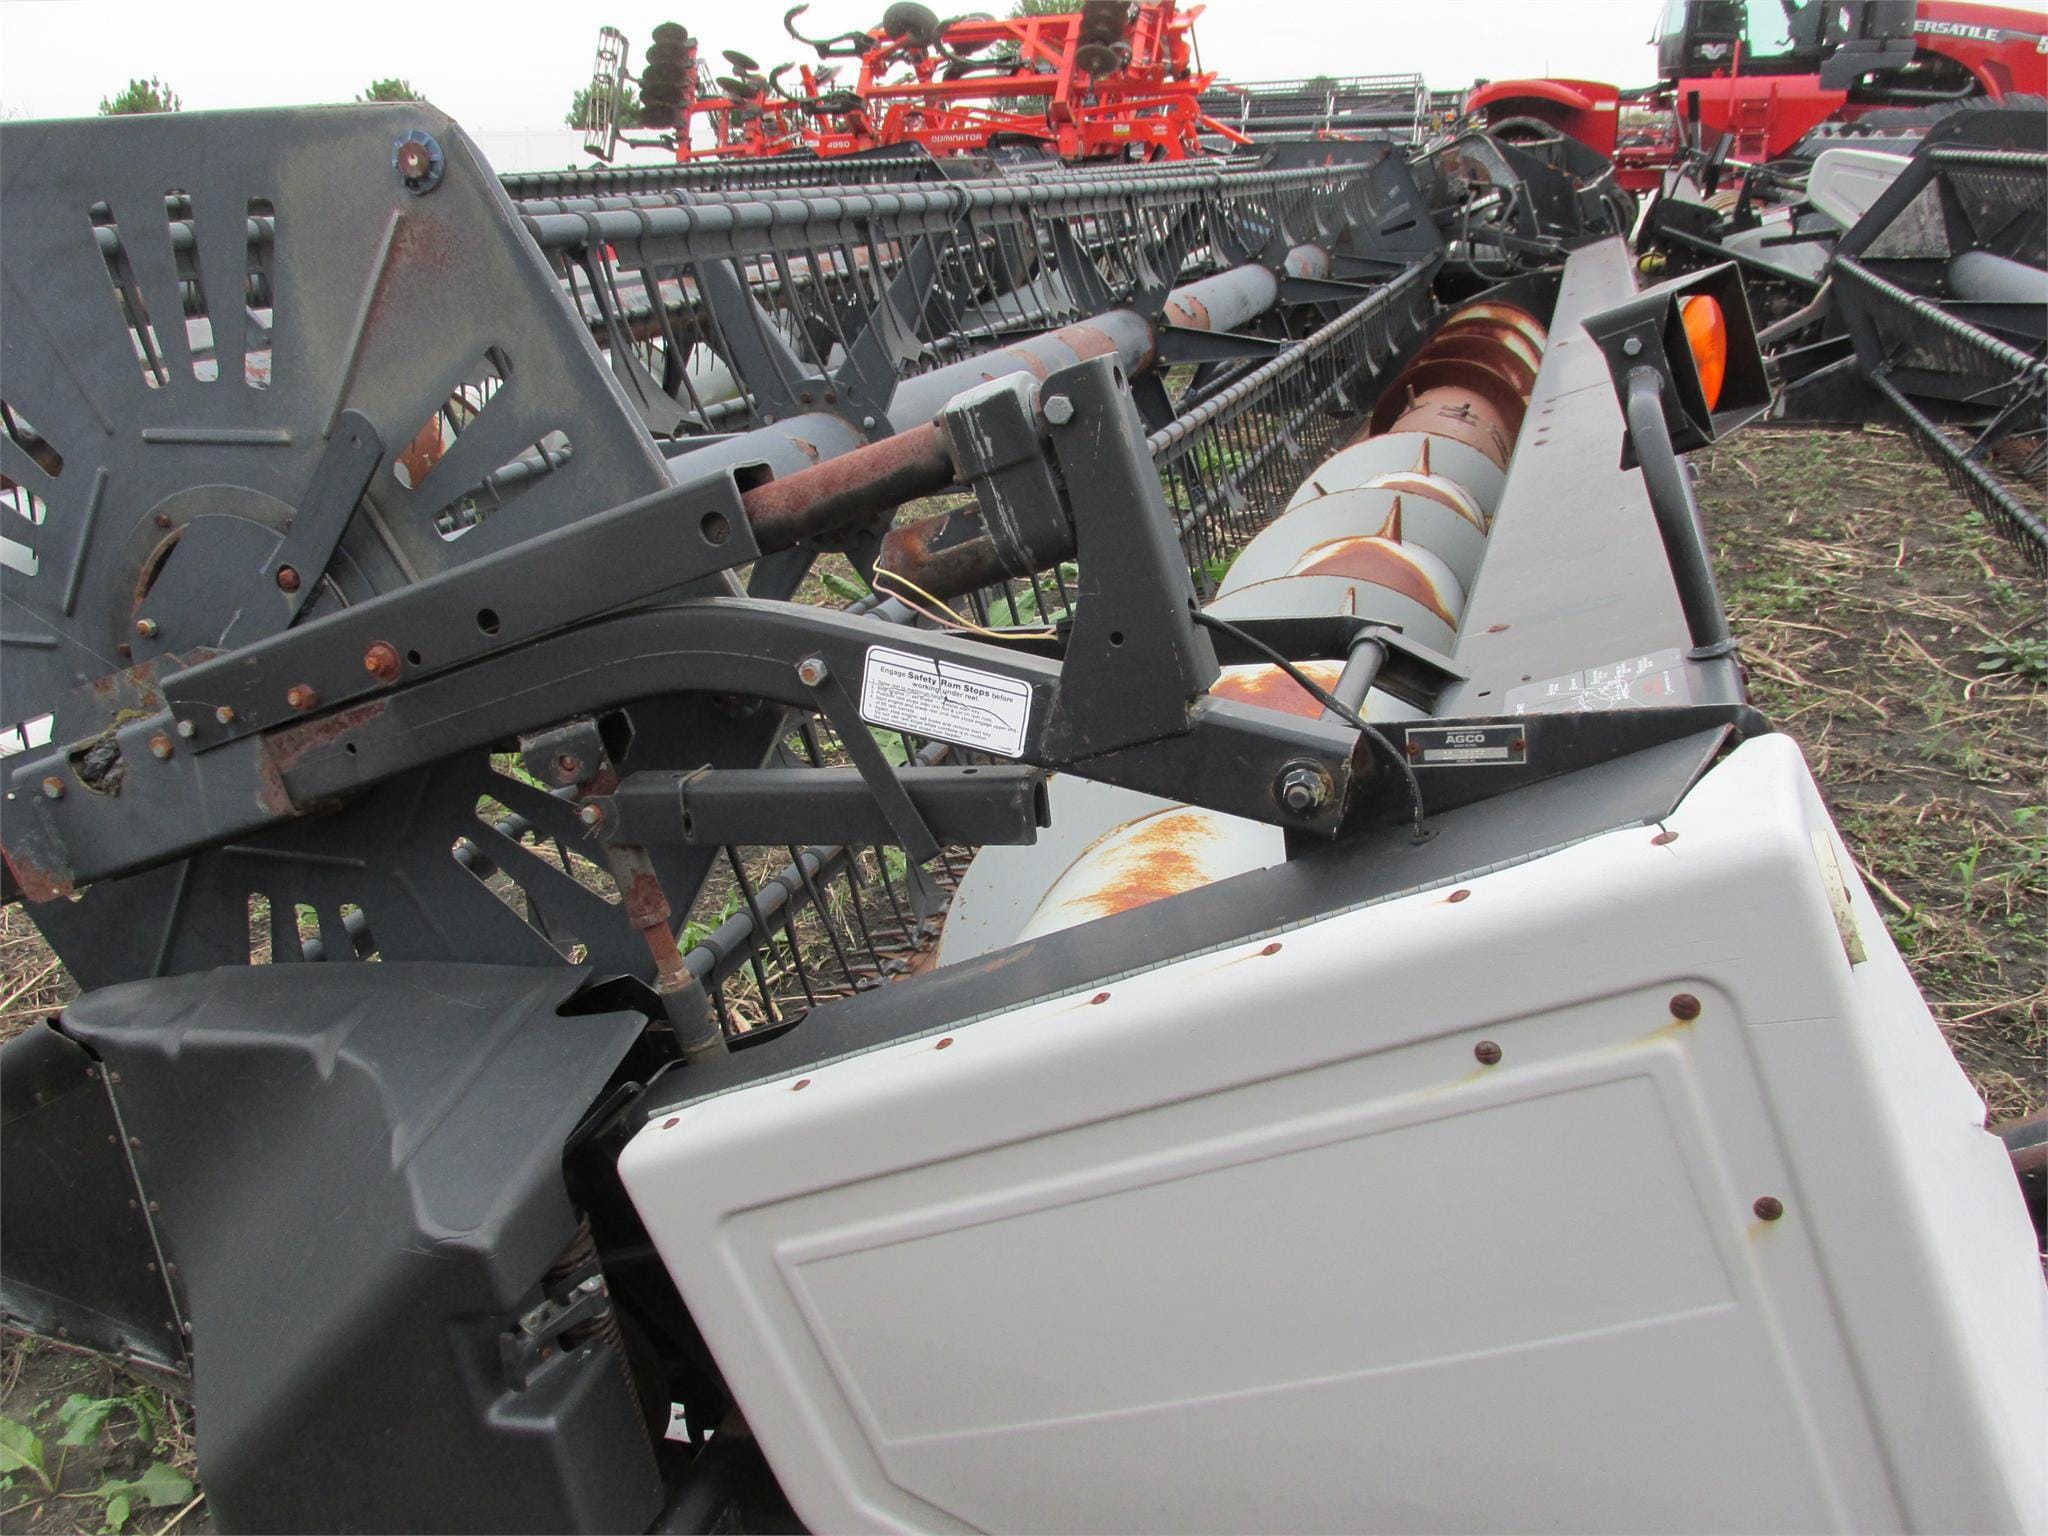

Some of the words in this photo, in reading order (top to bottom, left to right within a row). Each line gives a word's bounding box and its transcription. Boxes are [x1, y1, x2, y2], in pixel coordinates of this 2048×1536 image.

[1913, 20, 2000, 41] ERSATILE
[931, 133, 983, 143] DOMINATOR
[880, 666, 906, 678] Engage
[908, 671, 937, 686] Safety
[941, 679, 961, 690] Ram
[963, 684, 990, 697] Stops
[991, 693, 1014, 703] before
[912, 682, 939, 694] working
[942, 689, 963, 699] under
[1446, 735, 1486, 744] AGCO
